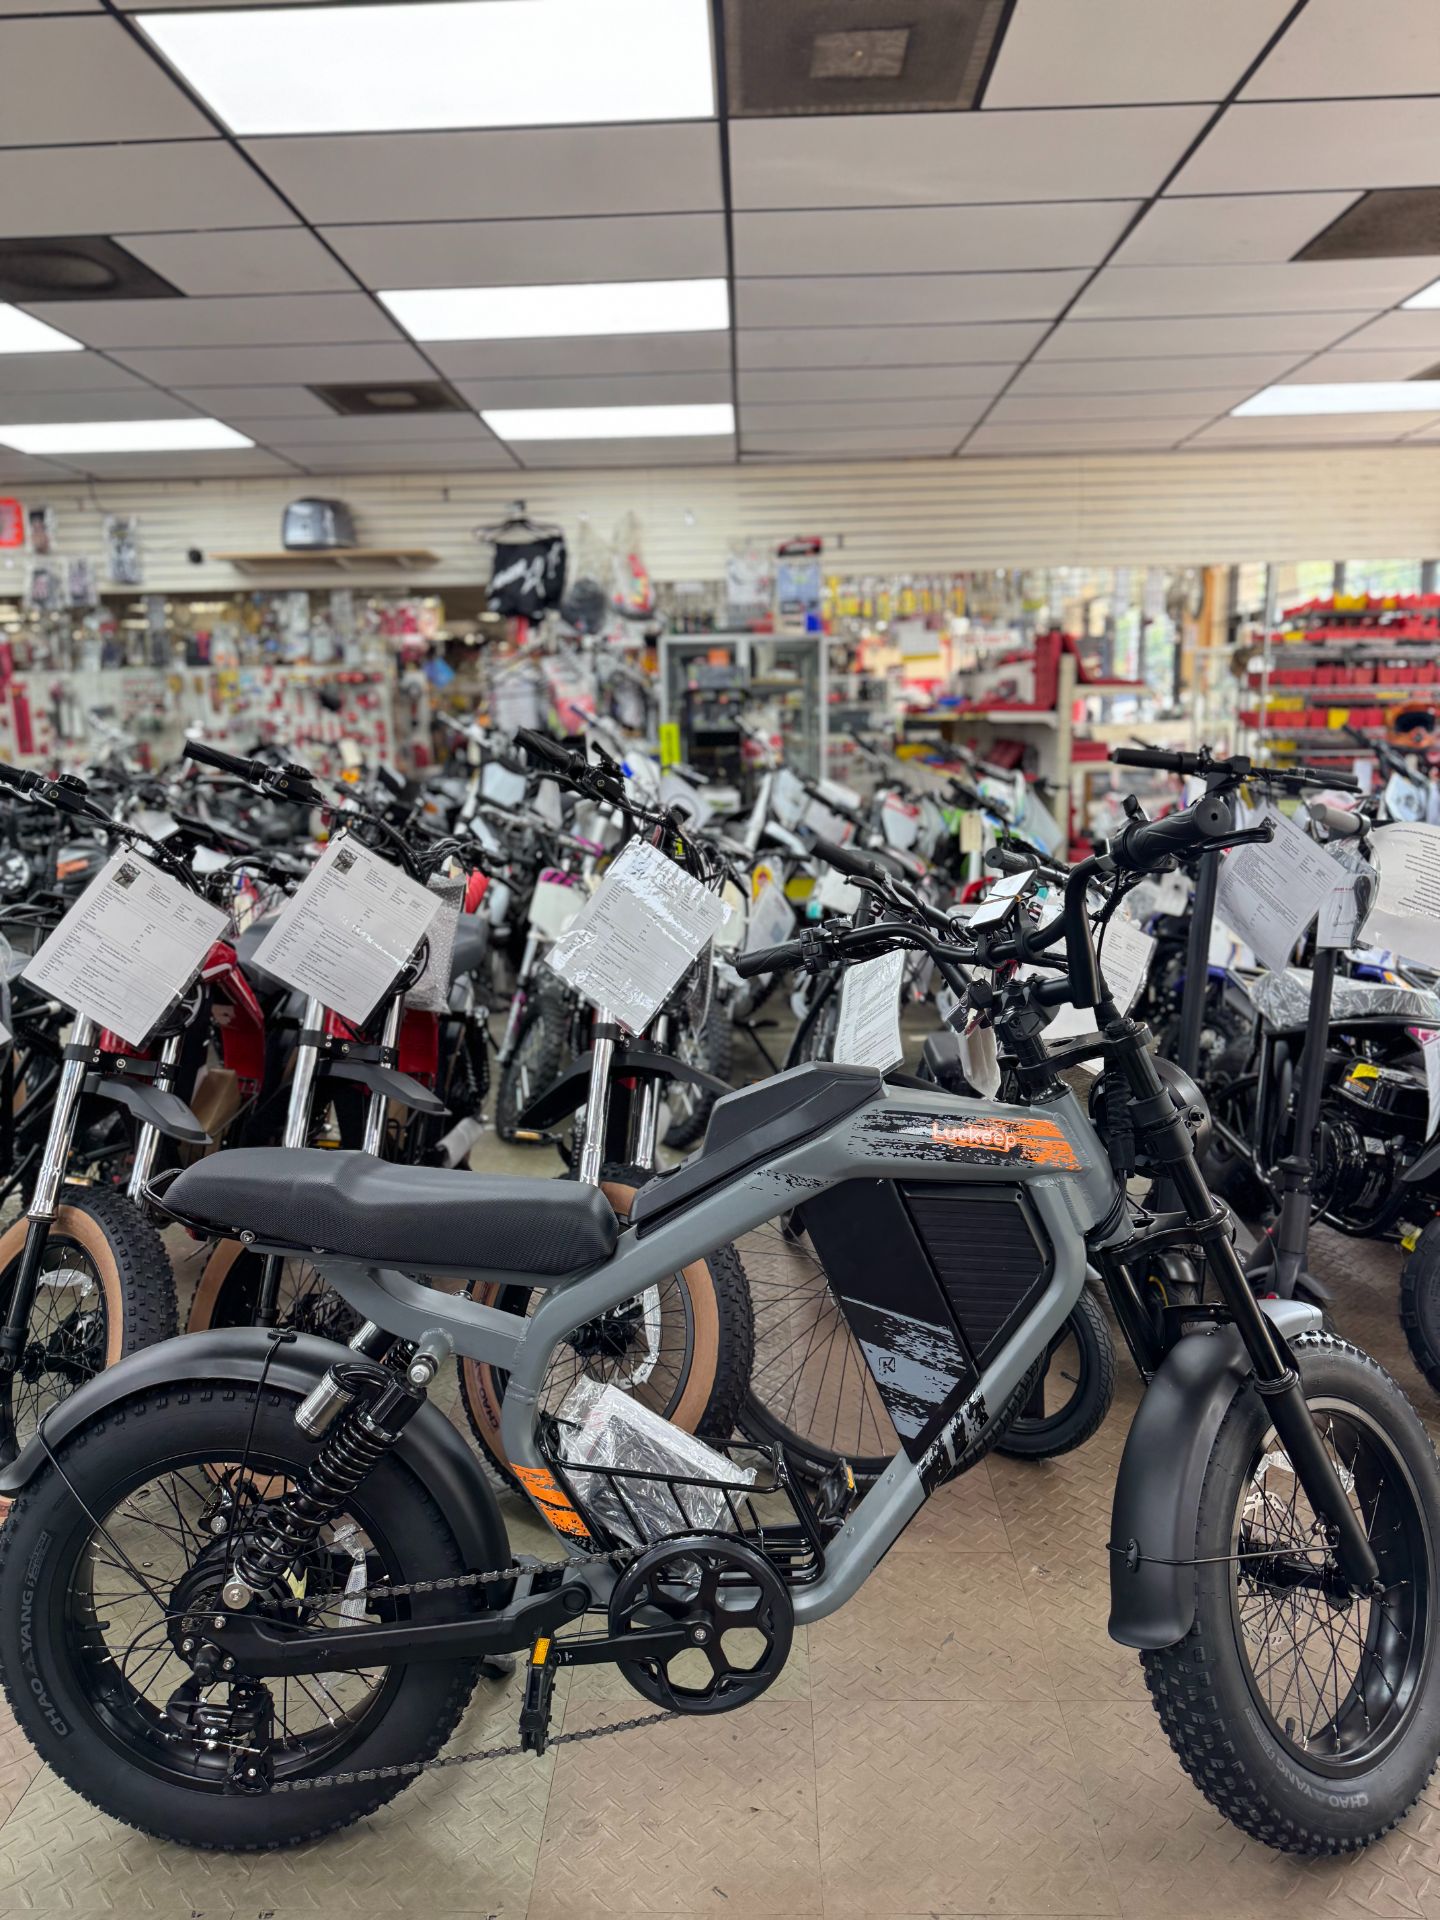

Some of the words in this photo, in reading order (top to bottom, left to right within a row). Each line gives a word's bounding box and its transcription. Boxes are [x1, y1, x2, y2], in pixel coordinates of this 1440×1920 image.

[932, 1122, 1017, 1151] Luckeep
[20, 1590, 34, 1653] YANG
[30, 1677, 69, 1736] CHAO
[1275, 1758, 1313, 1797] YANG
[1328, 1792, 1369, 1809] CHAO
